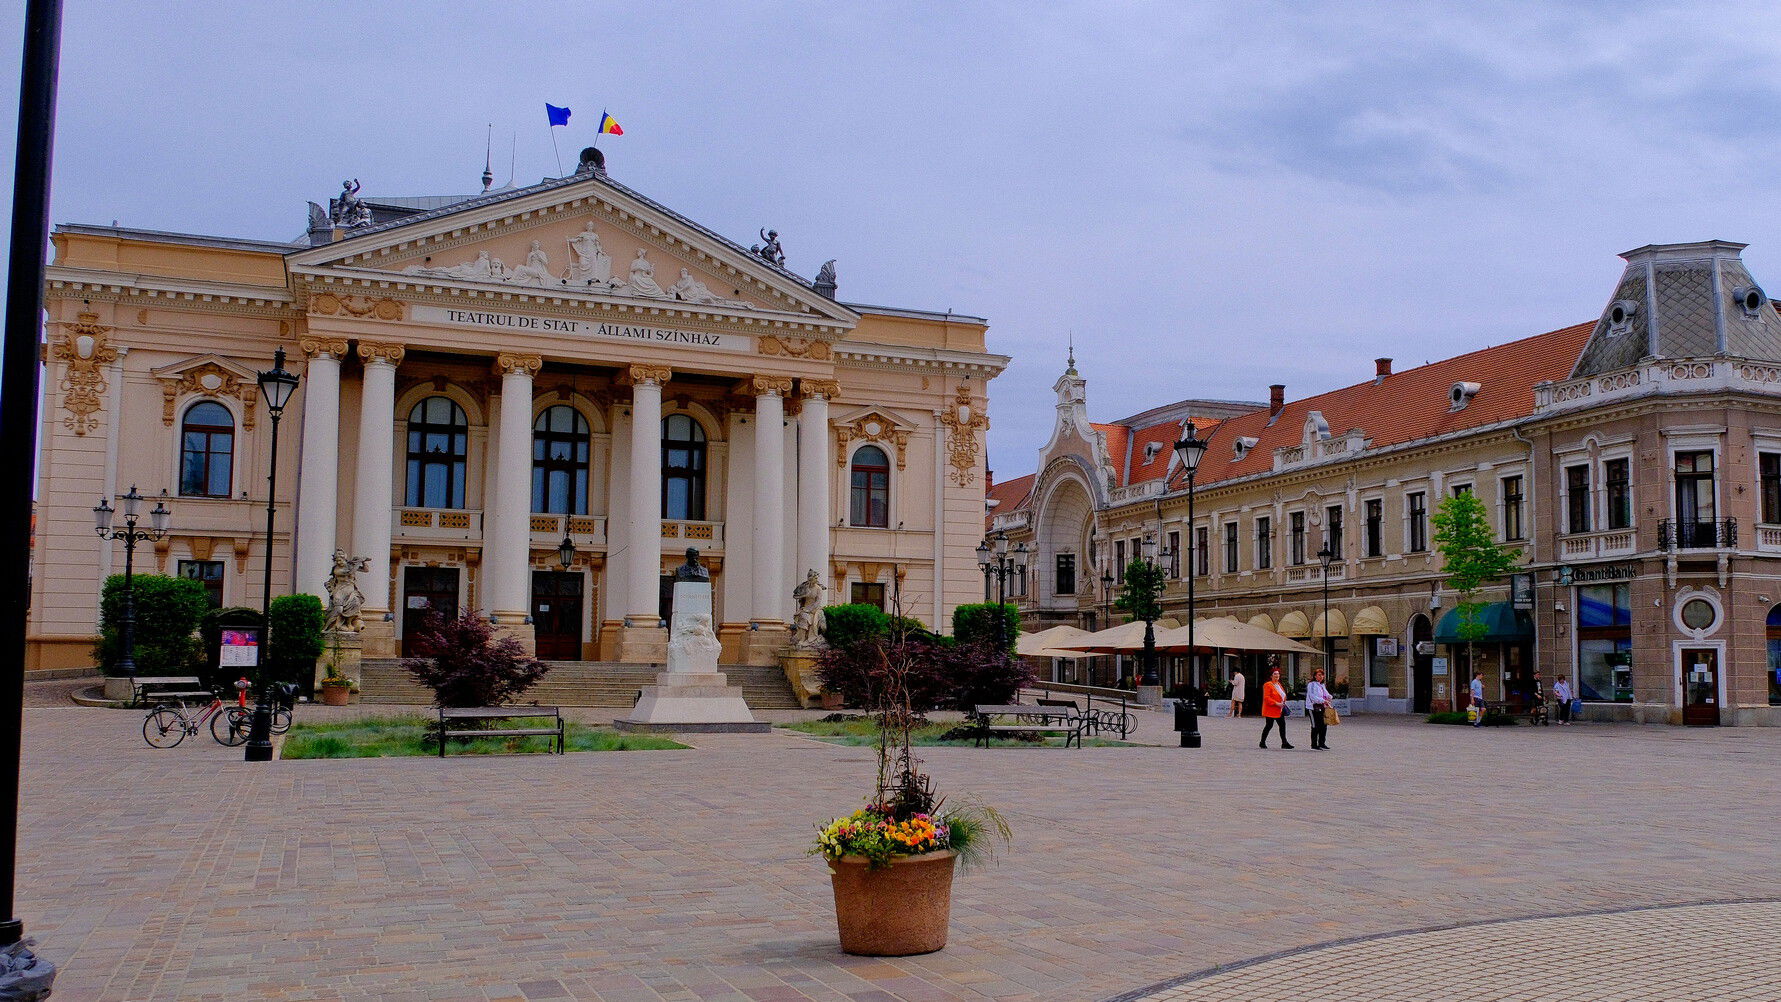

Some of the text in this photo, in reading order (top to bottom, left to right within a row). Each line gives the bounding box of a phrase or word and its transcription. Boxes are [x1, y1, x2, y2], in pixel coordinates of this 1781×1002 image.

[447, 310, 721, 346] TEATRUL DE STAT ÁLLAMI SZÍNHÁZ
